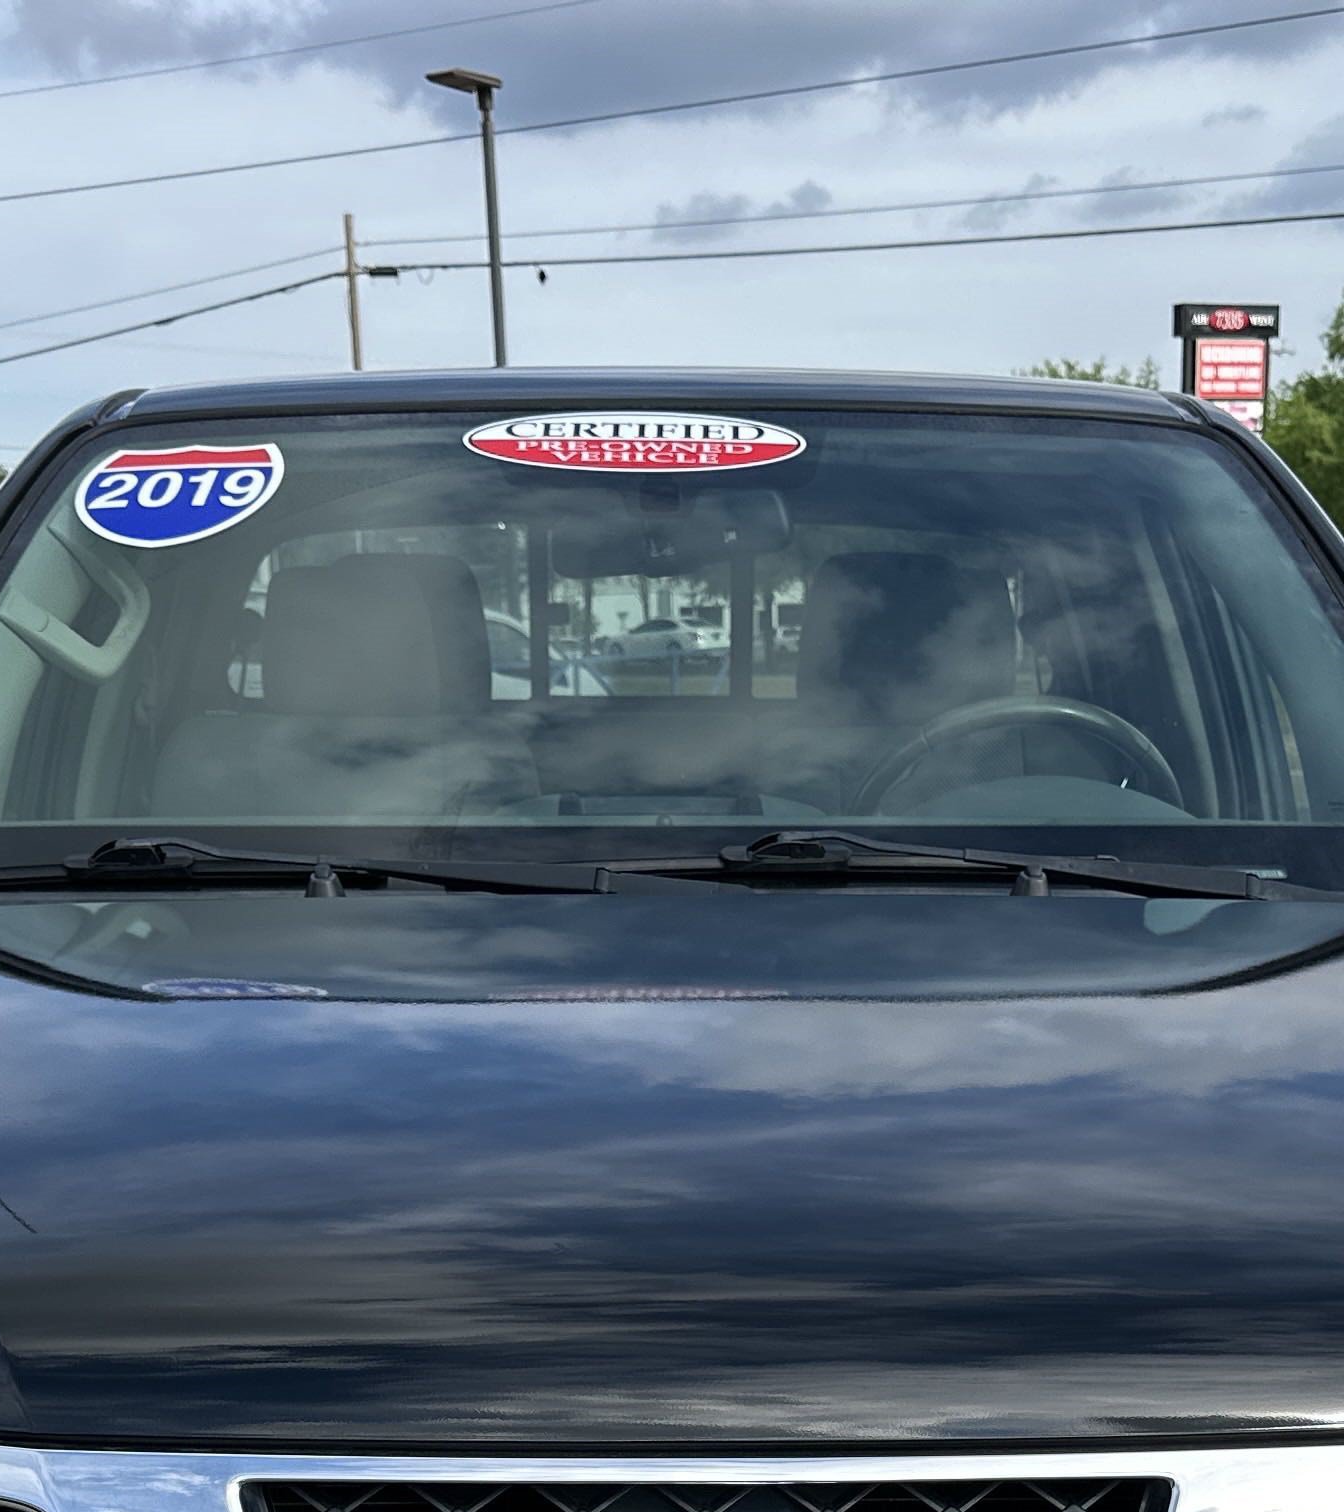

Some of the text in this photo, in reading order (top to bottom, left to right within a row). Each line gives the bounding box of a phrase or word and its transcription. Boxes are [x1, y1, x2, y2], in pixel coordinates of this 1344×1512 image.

[506, 421, 765, 441] CERTIFIED
[516, 440, 753, 455] PRE-OWNED
[550, 450, 720, 465] VEHICLE
[87, 468, 266, 509] 2019
